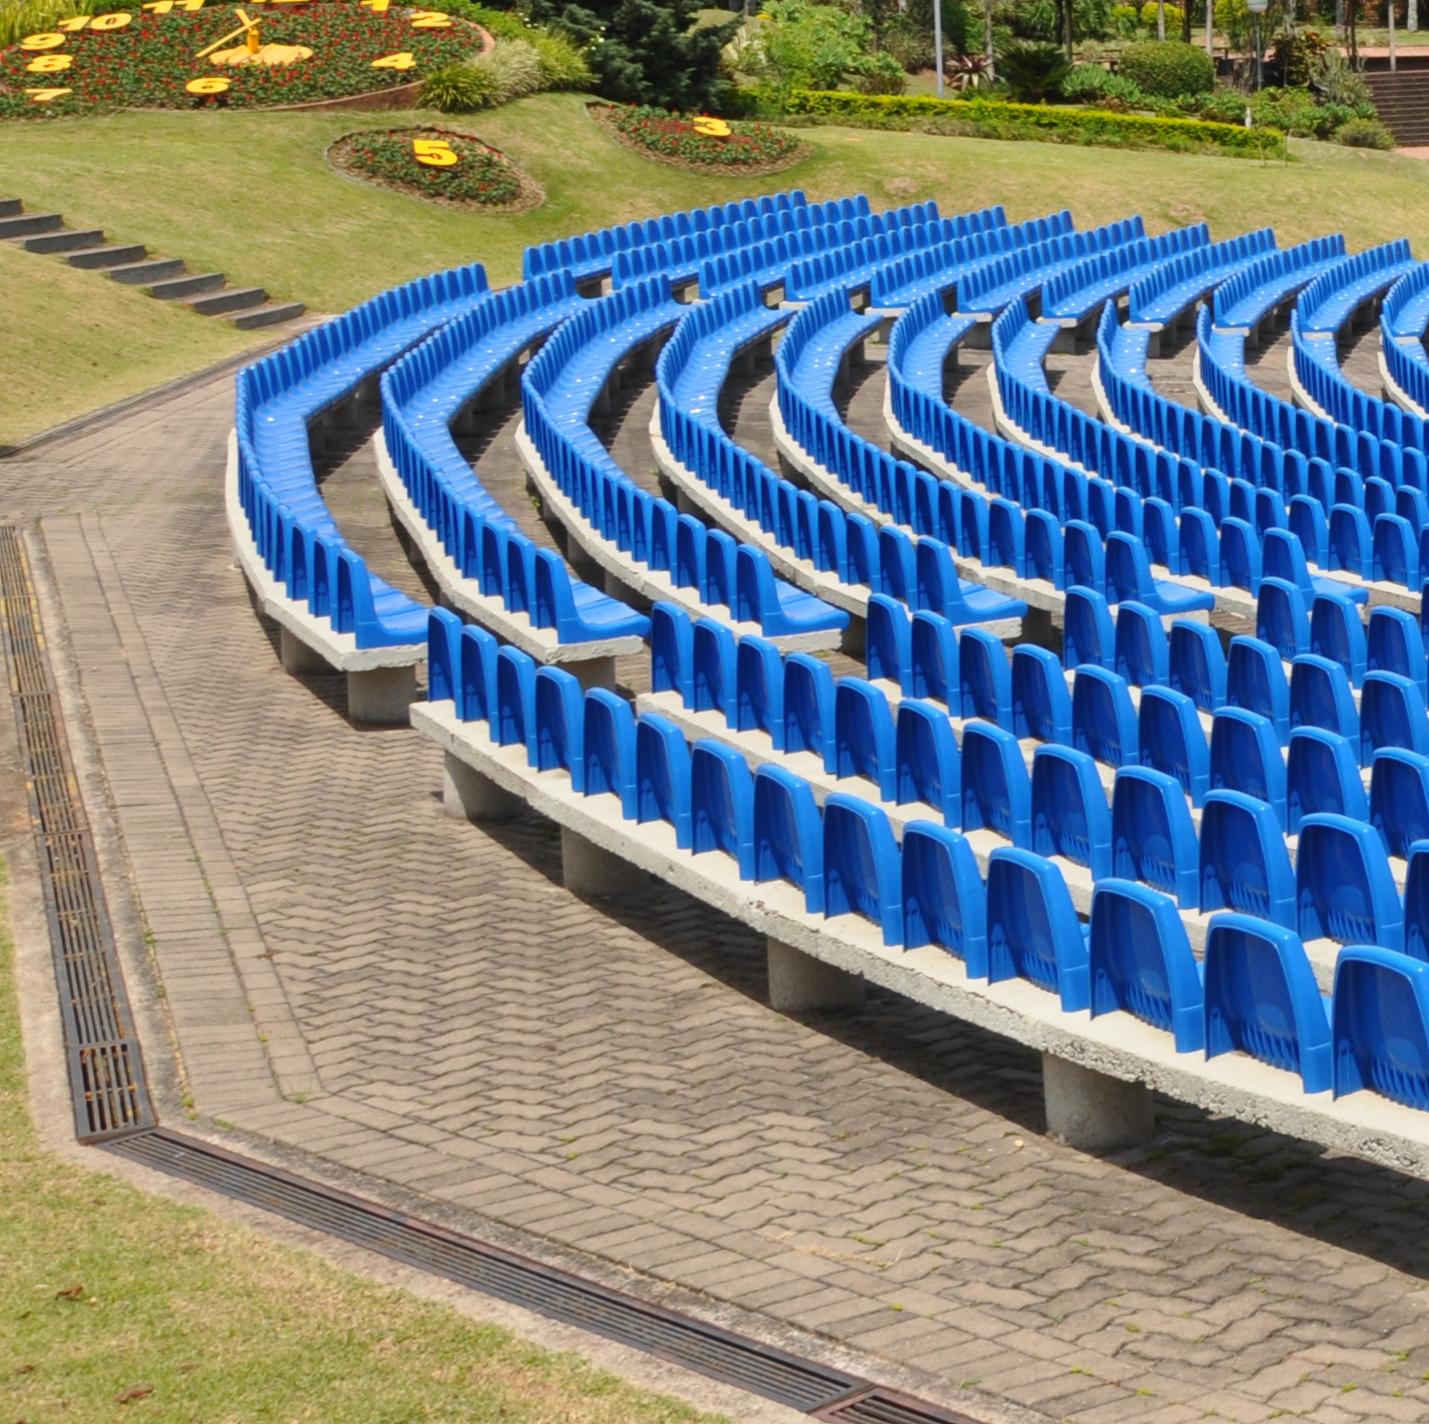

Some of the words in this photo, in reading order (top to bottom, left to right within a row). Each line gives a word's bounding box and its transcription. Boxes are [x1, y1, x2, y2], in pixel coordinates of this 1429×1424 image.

[58, 13, 132, 32] 10
[410, 12, 451, 27] 2
[21, 33, 66, 50] 9
[27, 55, 73, 72] 8
[371, 52, 417, 70] 4
[186, 78, 232, 94] 6
[24, 88, 73, 102] 7
[693, 116, 732, 137] 3
[412, 138, 459, 166] 5
